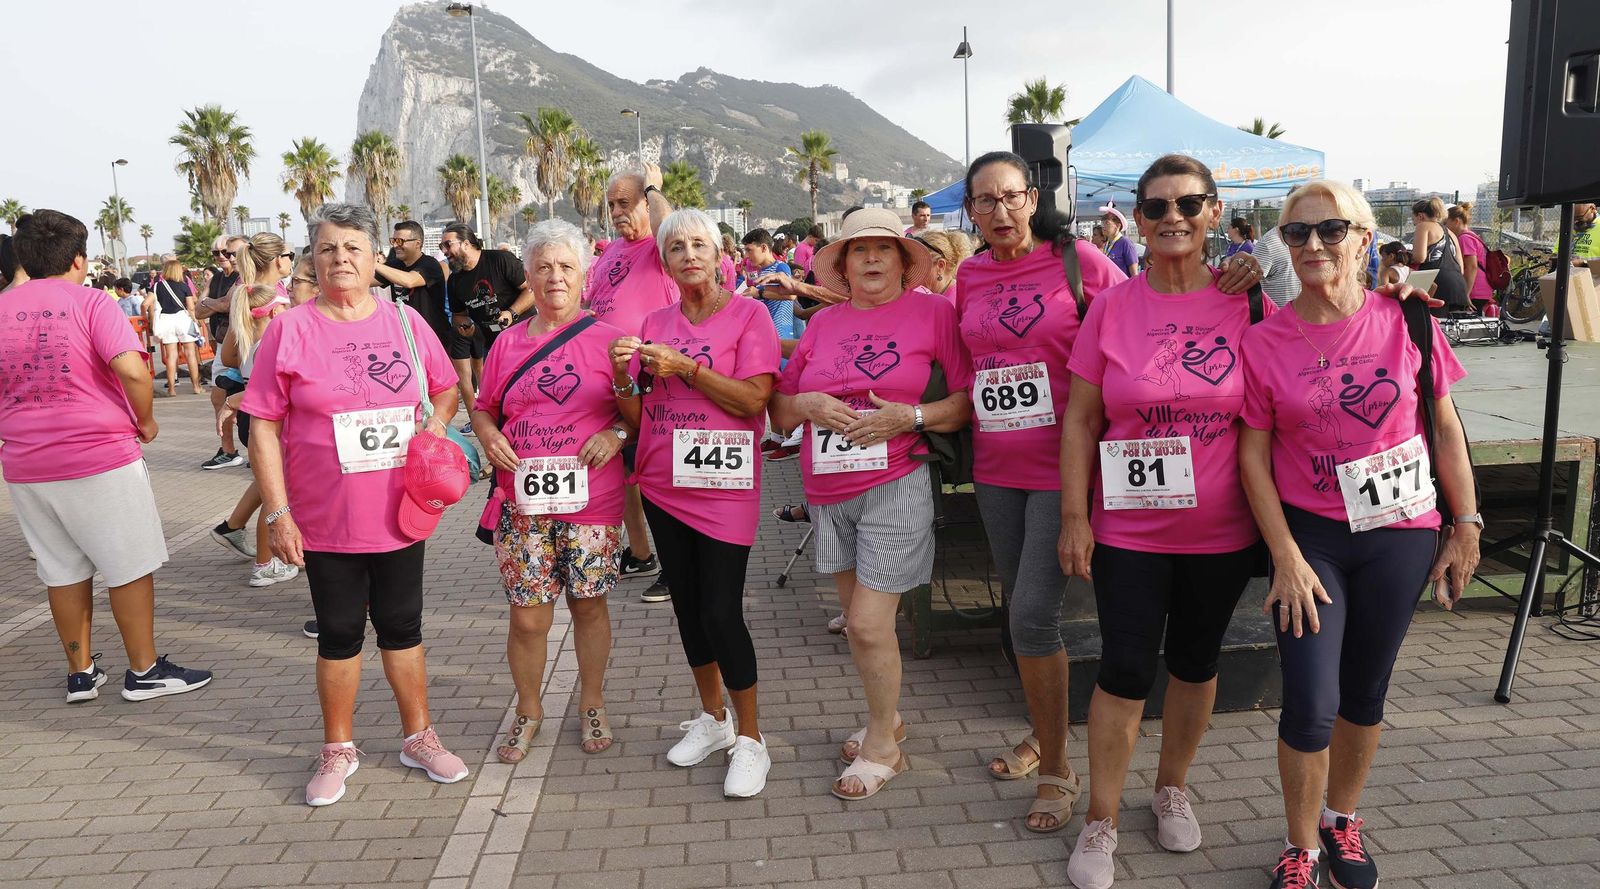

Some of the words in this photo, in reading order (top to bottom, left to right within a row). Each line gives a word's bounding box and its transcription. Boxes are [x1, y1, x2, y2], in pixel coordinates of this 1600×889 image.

[1211, 161, 1320, 183] deportes
[986, 377, 1000, 385] POR
[1002, 375, 1012, 384] LA
[1015, 370, 1045, 382] MUJER
[982, 382, 1038, 412] 689
[664, 408, 709, 422] Carrera
[1136, 405, 1171, 424] VIII
[1171, 407, 1231, 424] Carrera
[360, 424, 400, 451] 62
[510, 420, 529, 438] VIII
[528, 423, 576, 437] Carrera
[1145, 425, 1163, 438] de
[1165, 424, 1181, 438] la
[1189, 424, 1228, 447] Muje
[523, 438, 535, 451] la
[535, 435, 579, 454] Mujer
[693, 437, 709, 445] POR
[724, 437, 751, 446] MUJER
[817, 429, 867, 454] 73
[1122, 449, 1140, 458] POR
[1142, 448, 1152, 457] LA
[1154, 445, 1187, 457] MUJER
[529, 464, 544, 473] POR
[547, 463, 557, 472] LA
[684, 446, 743, 470] 445
[1128, 458, 1166, 487] 81
[524, 471, 576, 497] 681
[1312, 476, 1331, 492] de
[1358, 459, 1421, 507] 177
